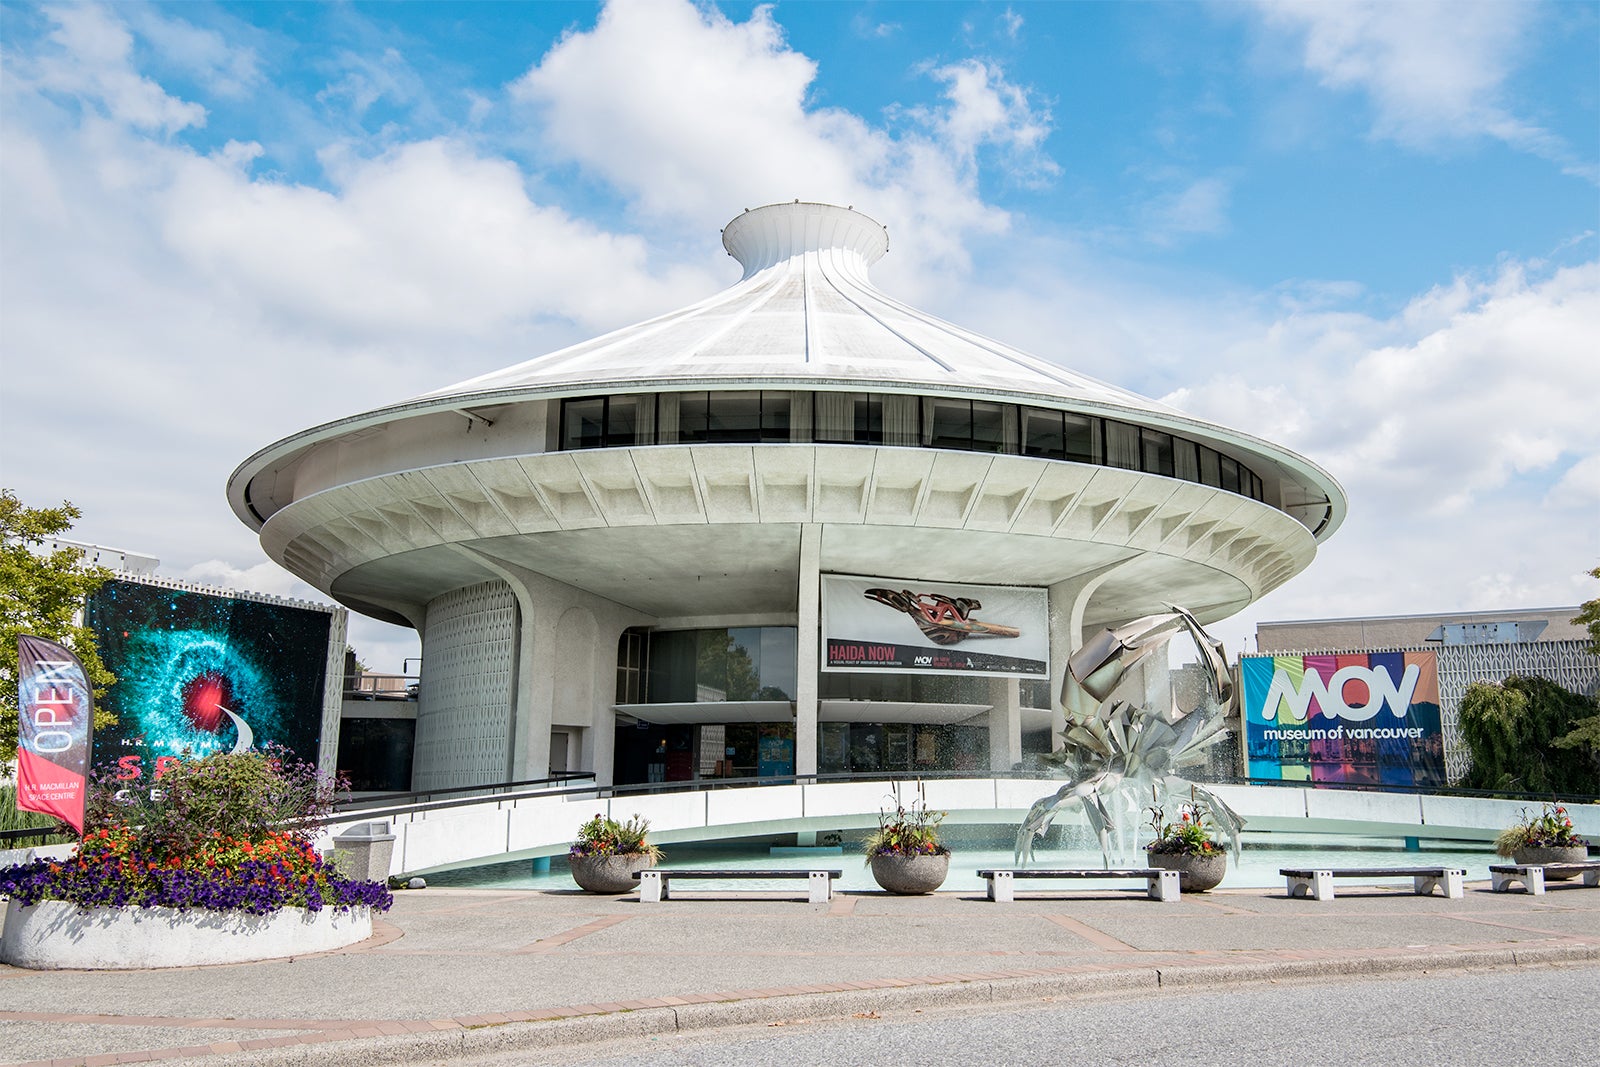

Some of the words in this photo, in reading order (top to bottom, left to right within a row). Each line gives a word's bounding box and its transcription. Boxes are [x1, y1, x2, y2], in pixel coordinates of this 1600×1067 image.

[829, 645, 865, 660] HAIDA
[868, 646, 896, 661] NOW
[914, 656, 932, 664] MOV
[1261, 664, 1420, 722] MOV
[33, 660, 73, 753] OPEN
[1263, 728, 1326, 741] museum
[1327, 725, 1344, 740] of
[1345, 727, 1424, 740] vancouver
[39, 781, 80, 791] MACMILLAN
